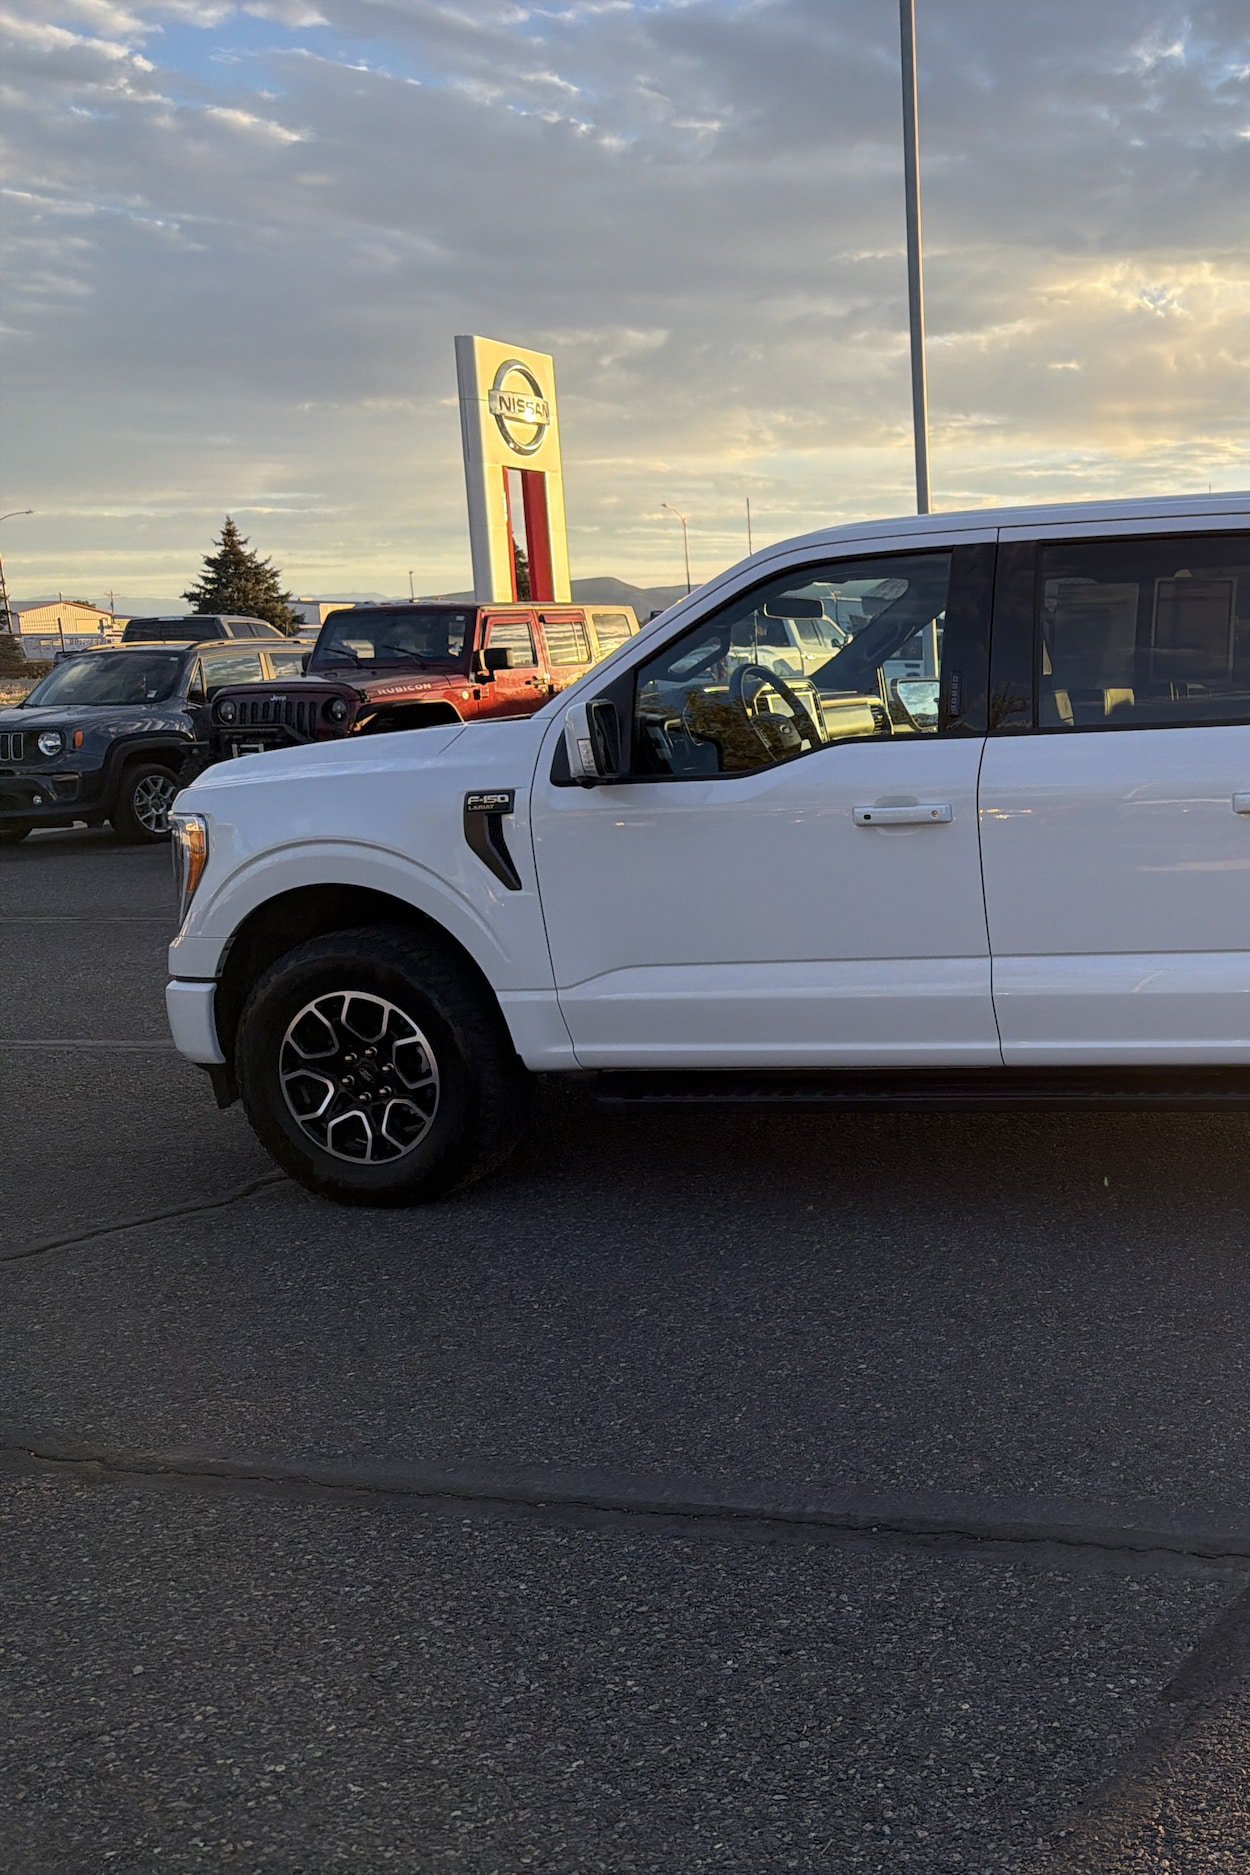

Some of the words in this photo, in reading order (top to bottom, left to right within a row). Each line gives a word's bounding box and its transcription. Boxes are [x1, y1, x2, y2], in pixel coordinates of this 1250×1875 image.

[498, 395, 549, 418] NISSAN
[377, 683, 432, 695] RUBICON
[270, 694, 287, 702] Jeep
[467, 794, 509, 805] F-150
